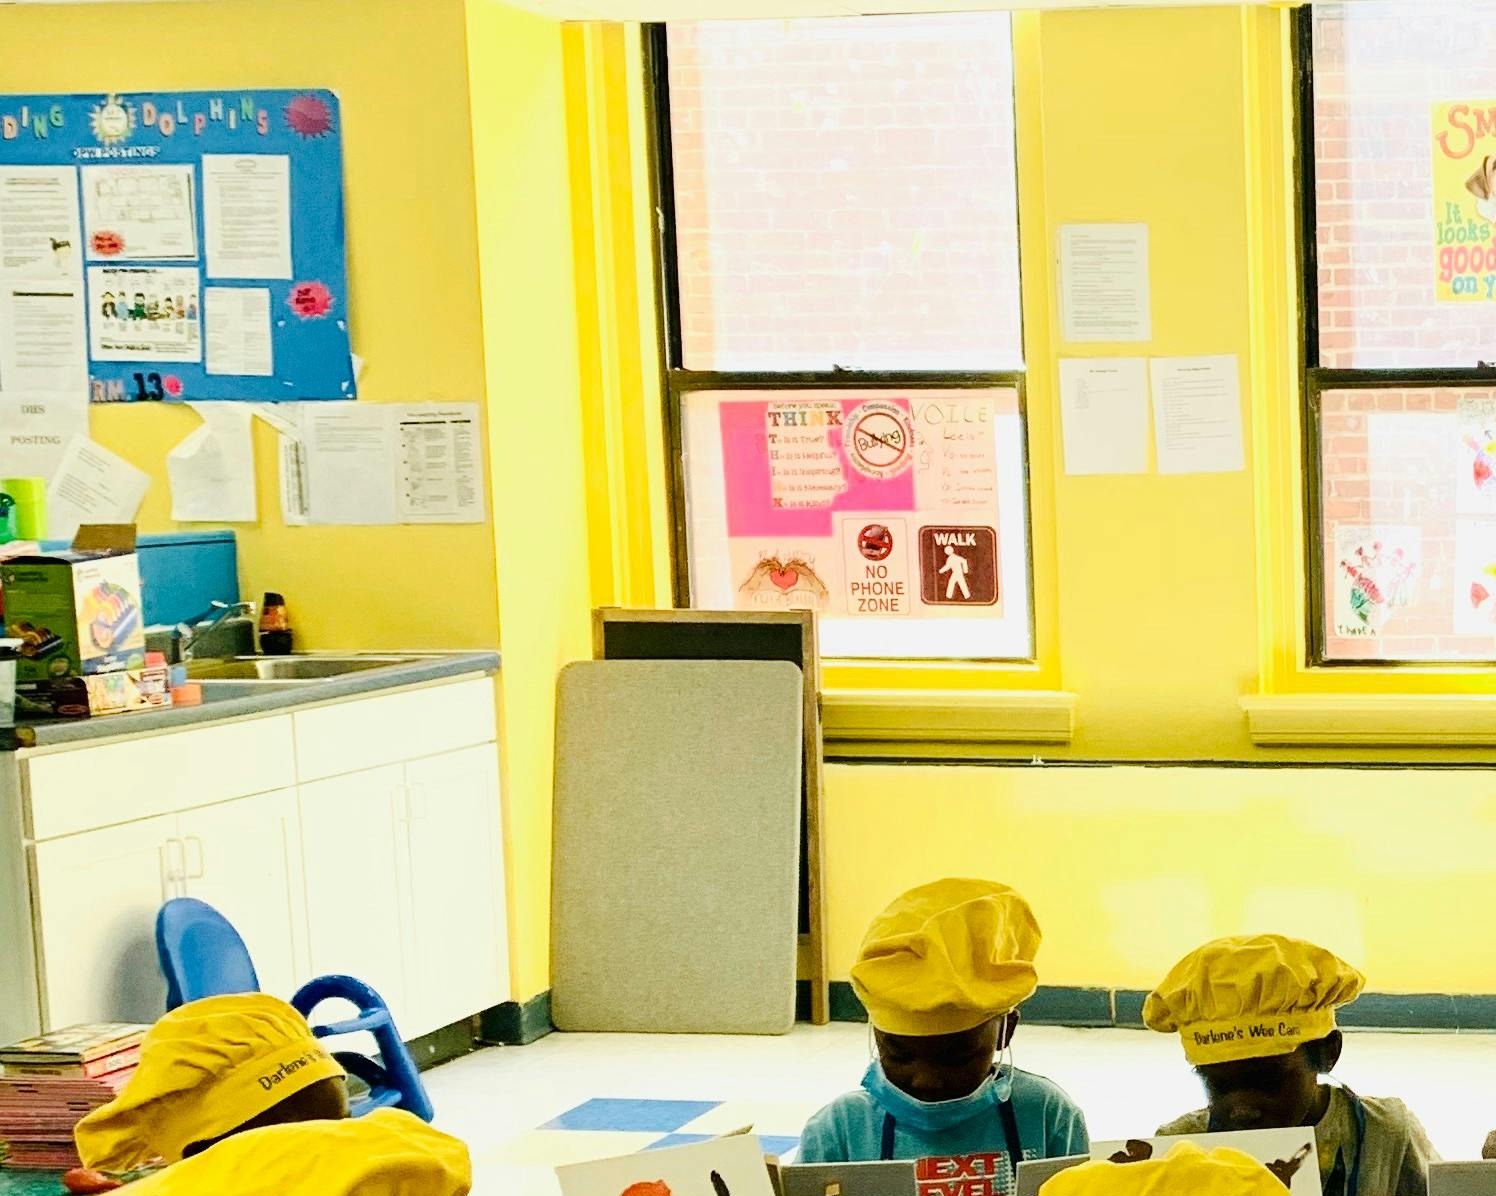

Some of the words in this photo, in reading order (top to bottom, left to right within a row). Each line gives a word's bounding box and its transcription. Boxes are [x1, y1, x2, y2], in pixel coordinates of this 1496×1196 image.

[2, 105, 65, 139] DING
[142, 98, 269, 136] DOLPHINS
[1446, 202, 1462, 225] It
[1437, 219, 1490, 245] looks
[1452, 276, 1478, 294] on
[134, 373, 164, 400] 13
[767, 411, 842, 427] THINK
[10, 435, 61, 445] POSTING
[935, 532, 976, 546] WALK
[866, 565, 888, 578] NO
[851, 582, 905, 595] PHONE
[858, 598, 899, 612] ZONE
[1194, 1026, 1244, 1045] Darlene's
[1249, 1025, 1275, 1038] Wee
[1278, 1022, 1301, 1036] Care
